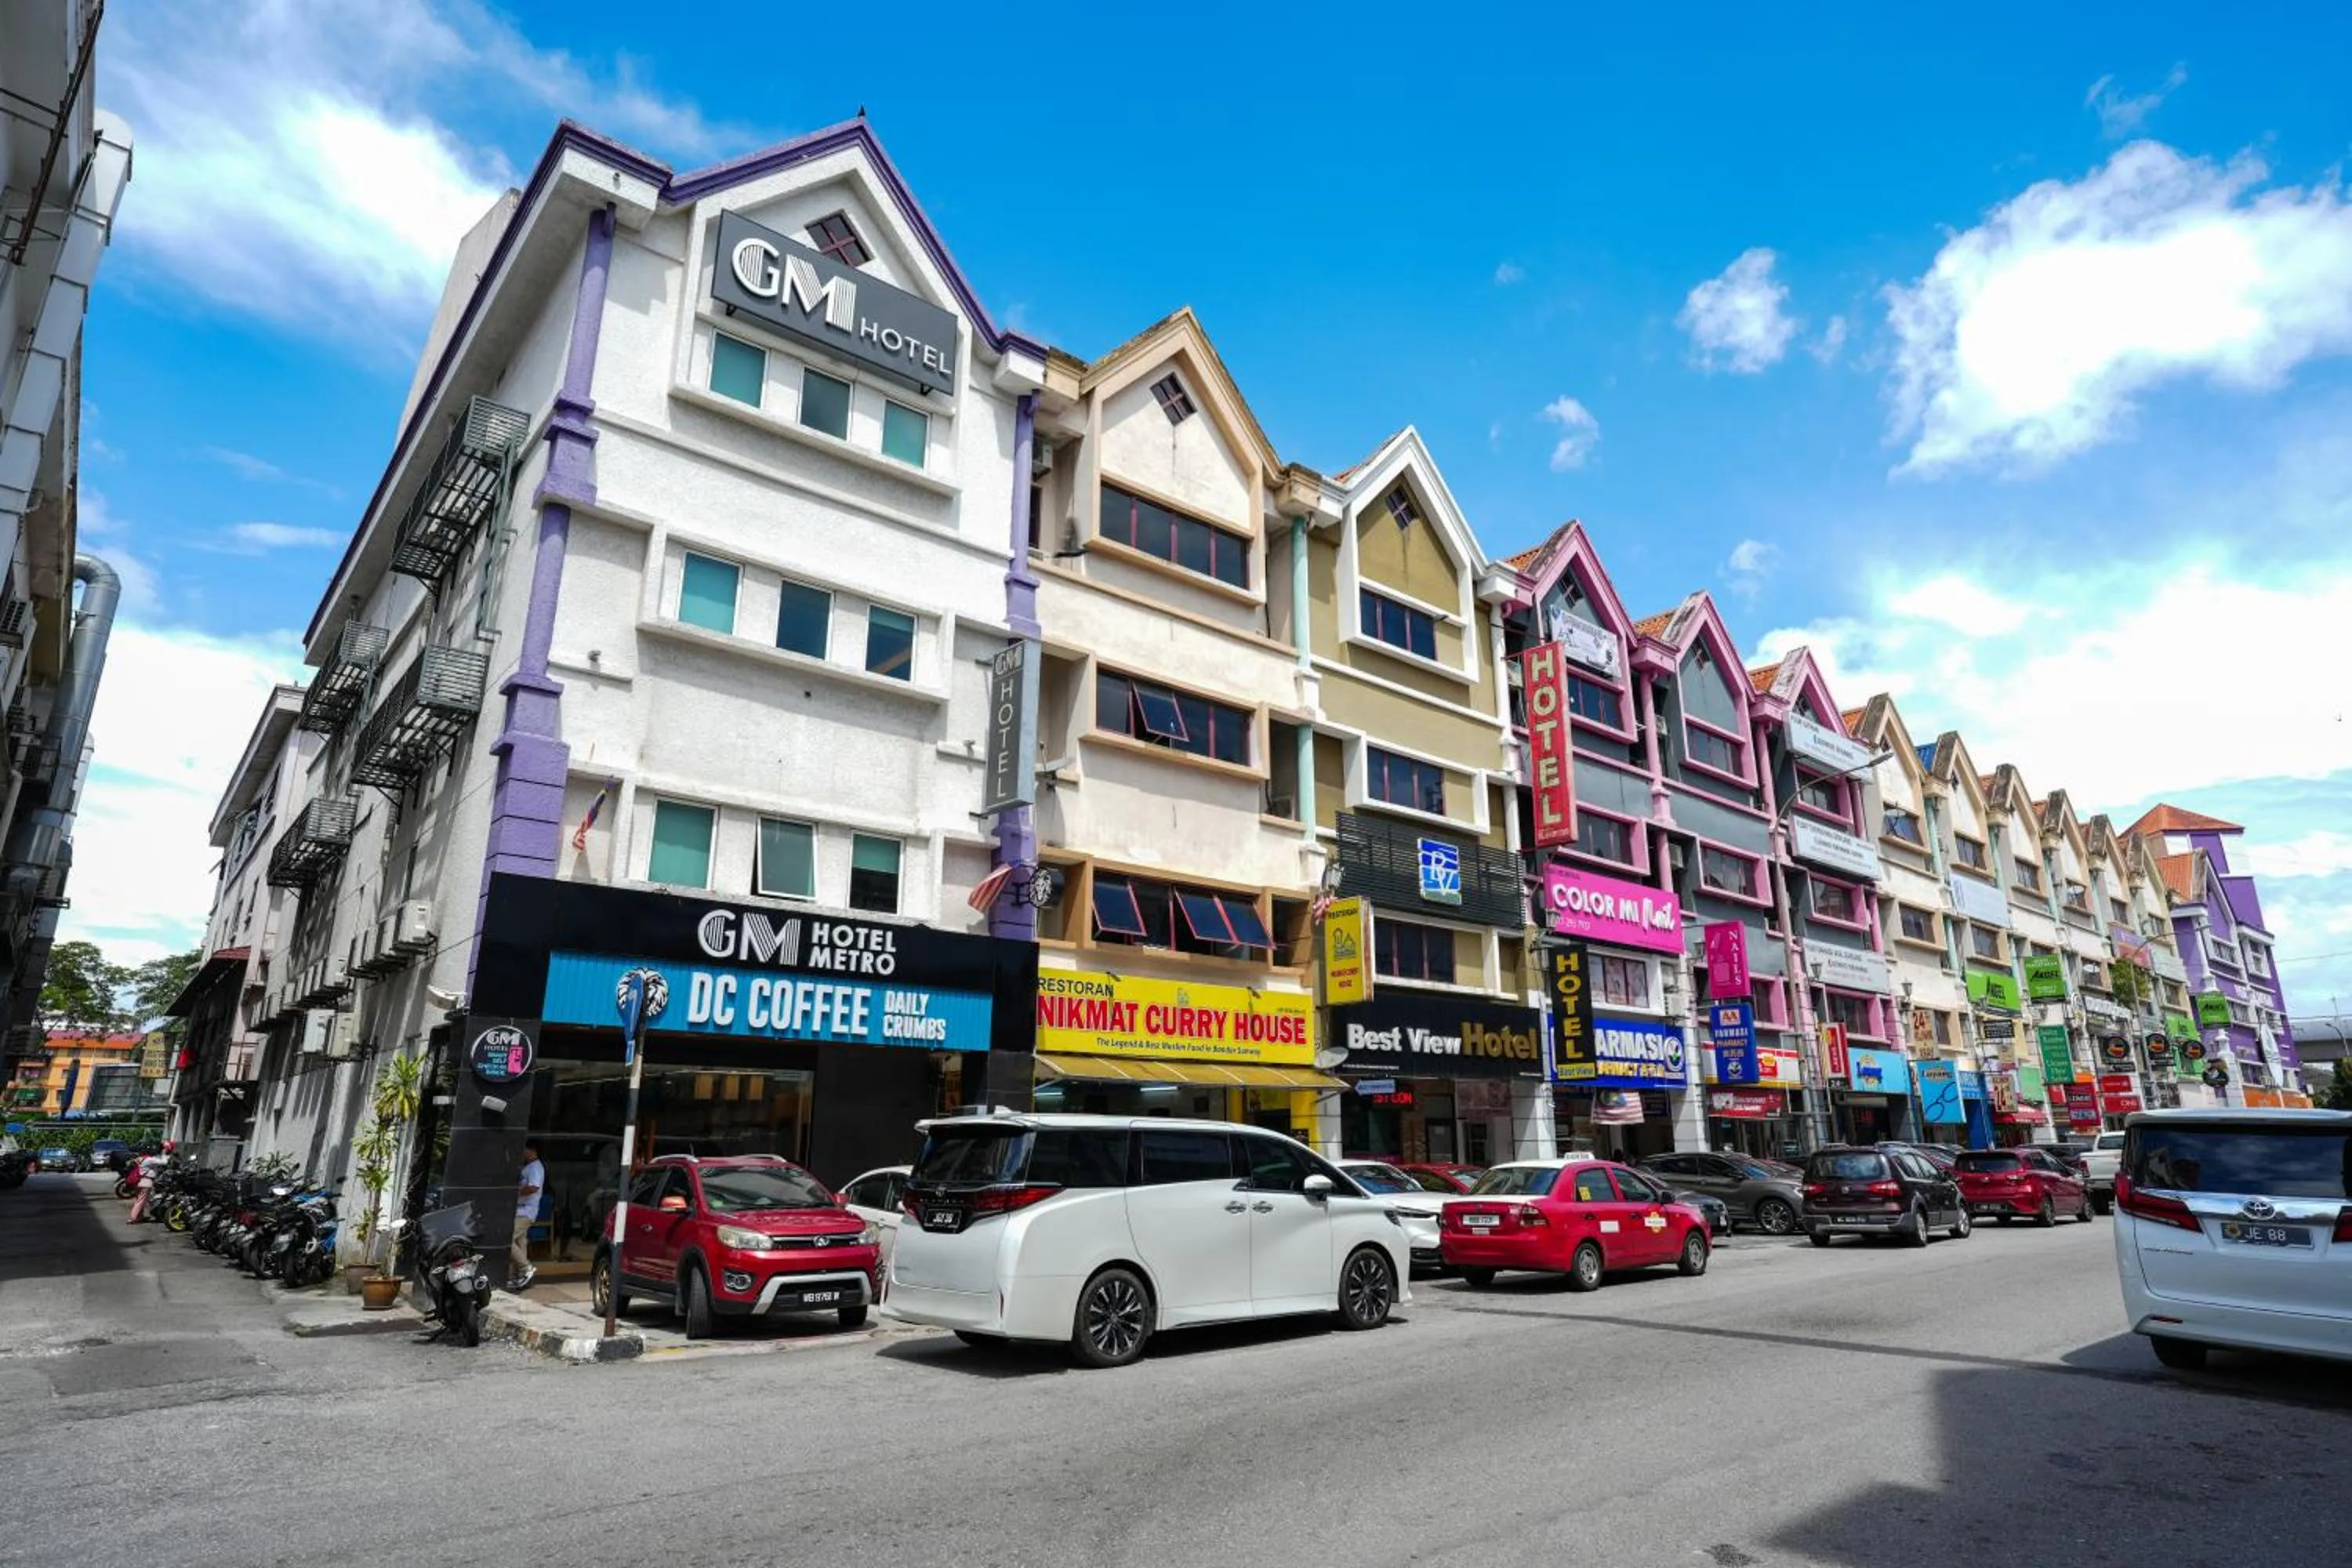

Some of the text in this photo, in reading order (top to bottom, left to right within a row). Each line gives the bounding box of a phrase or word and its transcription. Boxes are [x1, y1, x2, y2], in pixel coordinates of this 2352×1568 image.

[731, 238, 953, 376] GM HOTEL
[995, 645, 1022, 675] GM
[996, 678, 1014, 798] HOTEL
[1530, 648, 1563, 824] HOTEL
[1552, 883, 1616, 919] COLOR
[697, 909, 802, 967] GM
[811, 921, 896, 953] HOTEL
[808, 946, 896, 975] METRO
[1728, 929, 1743, 985] NAILS
[688, 971, 871, 1036] DC COFFEE
[884, 990, 929, 1016] DAILY
[1037, 977, 1114, 998] RESTORAN
[1037, 995, 1307, 1046] NIKMAT CURRY HOUSE
[1556, 952, 1584, 1059] HOTEL
[486, 1031, 521, 1045] GM
[882, 1014, 946, 1040] CRUMBS
[1111, 1038, 1138, 1049] Legend
[1346, 1022, 1538, 1060] Best View Hotel
[1594, 1029, 1664, 1061] ARMASI
[2245, 1226, 2286, 1241] JE 88
